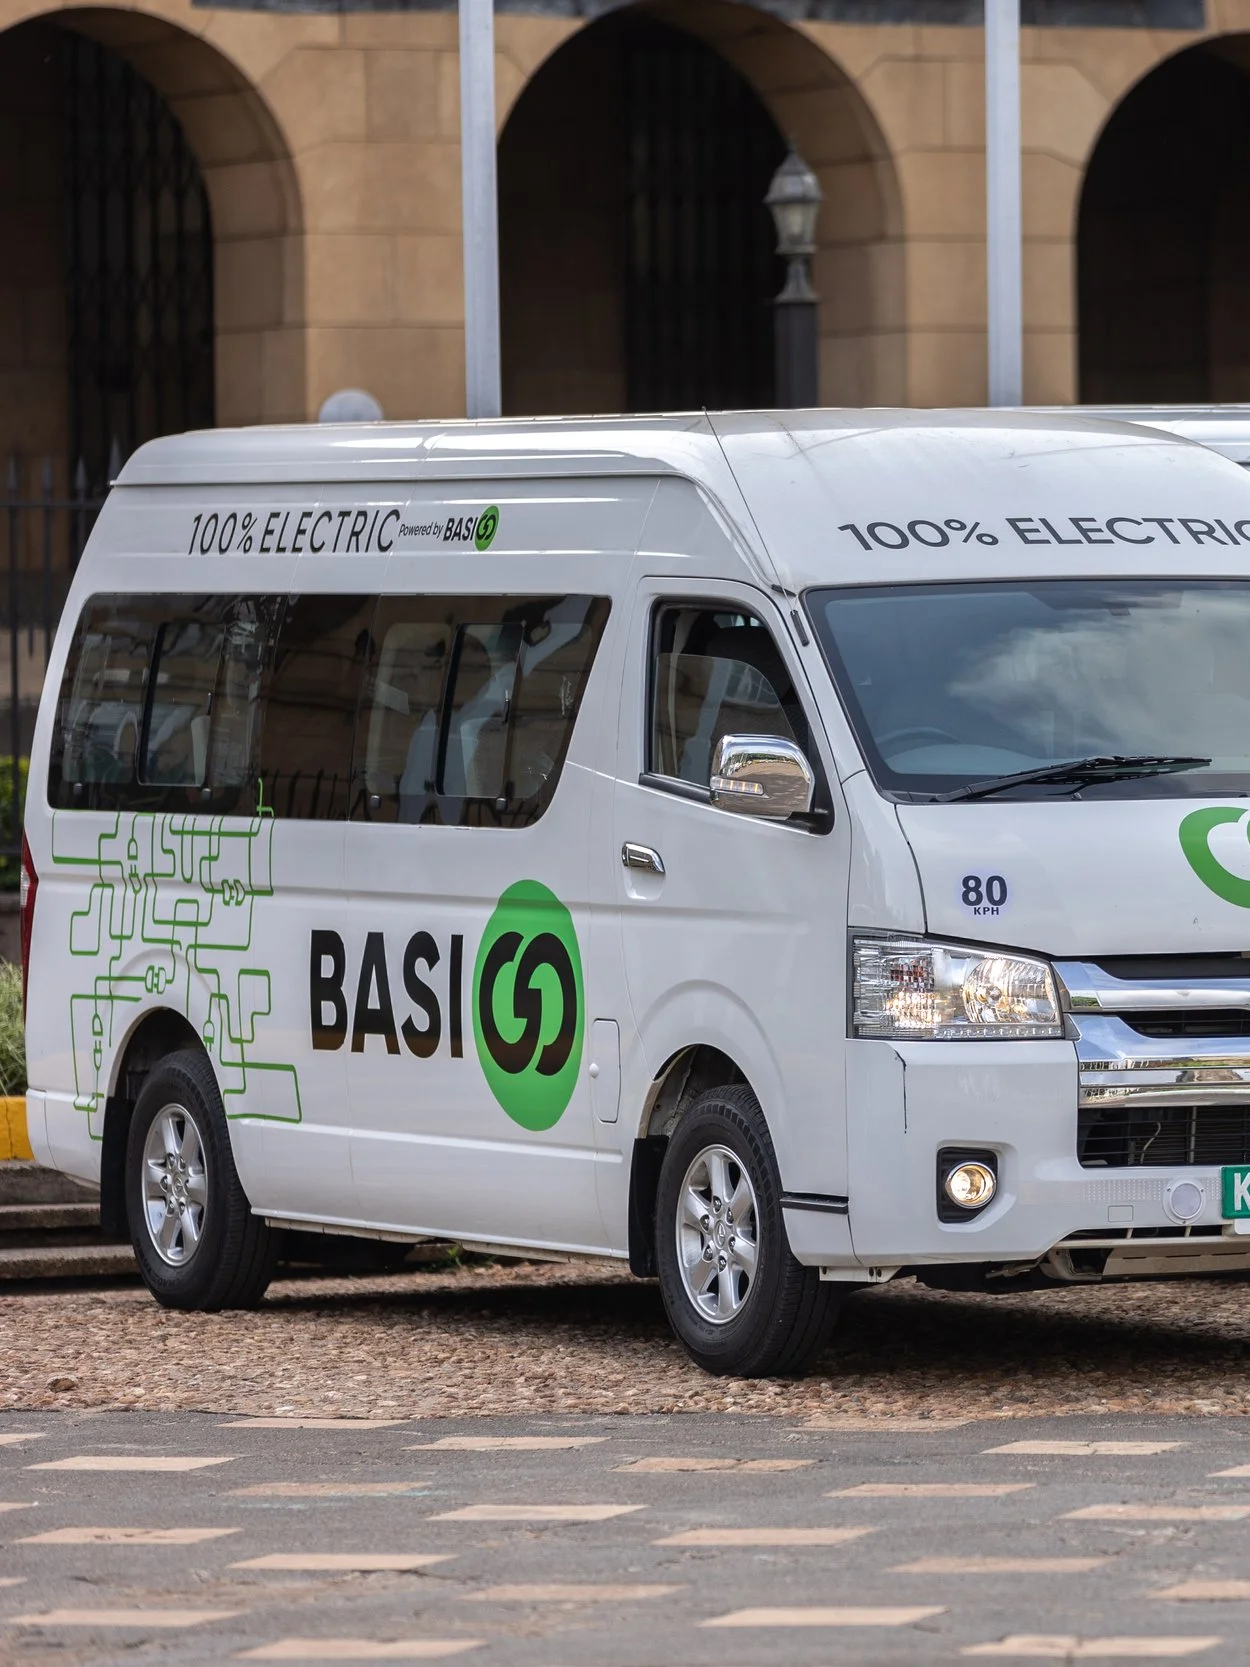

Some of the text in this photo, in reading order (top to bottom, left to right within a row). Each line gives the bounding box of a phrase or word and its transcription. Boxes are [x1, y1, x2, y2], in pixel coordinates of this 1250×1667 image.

[188, 509, 400, 555] 100% ELECTRIC
[398, 522, 434, 537] Powered
[433, 521, 443, 538] by
[837, 518, 999, 551] 100%
[961, 875, 1007, 906] 80
[973, 907, 999, 915] KPH
